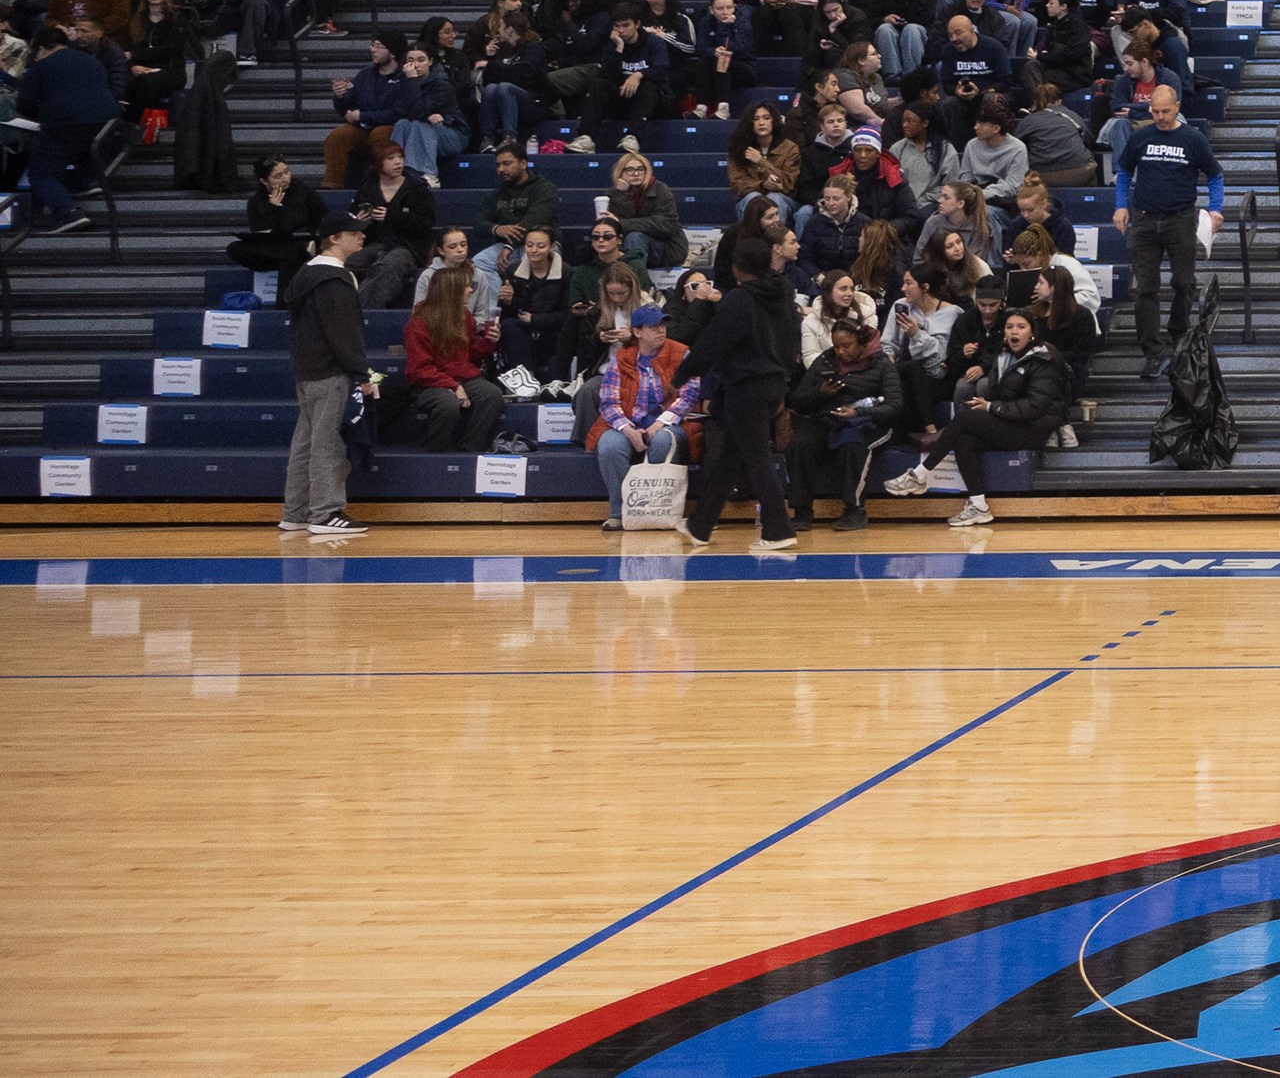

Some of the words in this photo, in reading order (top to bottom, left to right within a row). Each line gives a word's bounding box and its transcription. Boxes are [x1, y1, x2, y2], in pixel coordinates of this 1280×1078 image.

[1146, 144, 1186, 158] DEPAUL
[484, 470, 518, 478] Community
[629, 478, 677, 488] GENUINE
